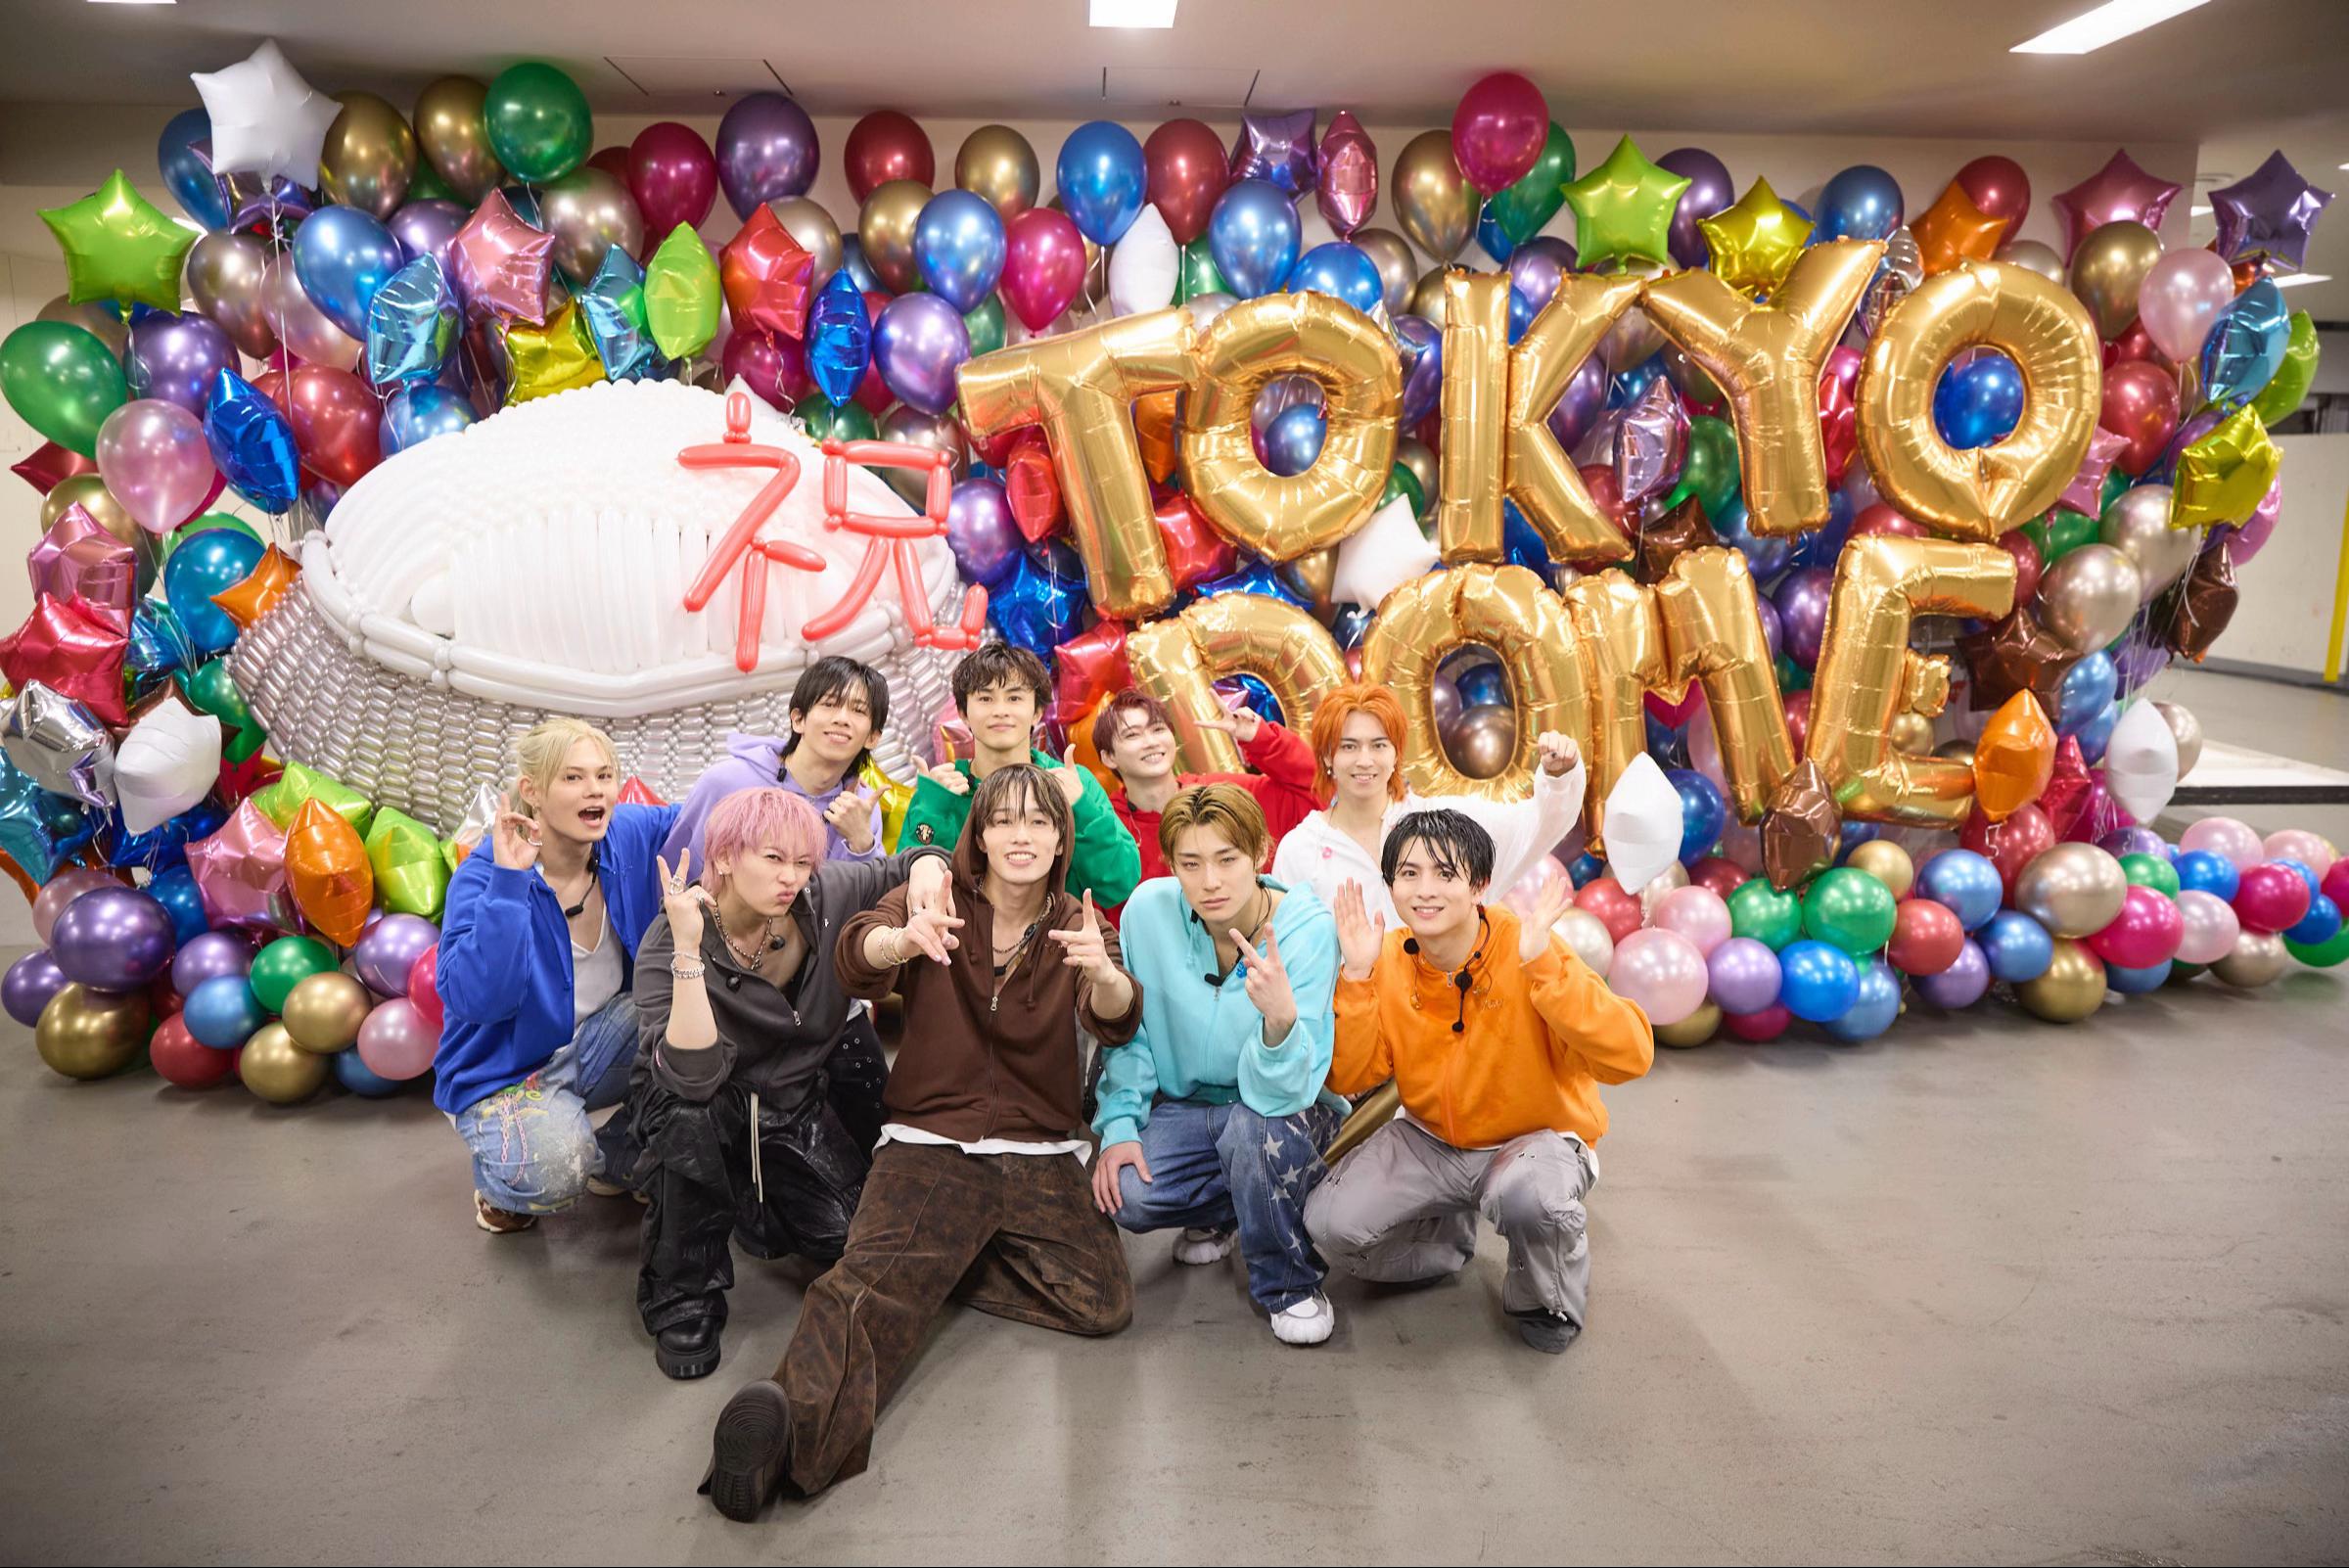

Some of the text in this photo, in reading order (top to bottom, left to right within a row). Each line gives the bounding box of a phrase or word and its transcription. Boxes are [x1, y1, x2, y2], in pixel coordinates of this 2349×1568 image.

[677, 392, 988, 672] 祝
[955, 239, 2103, 619] TOKYO
[1127, 533, 2016, 858] DOME
